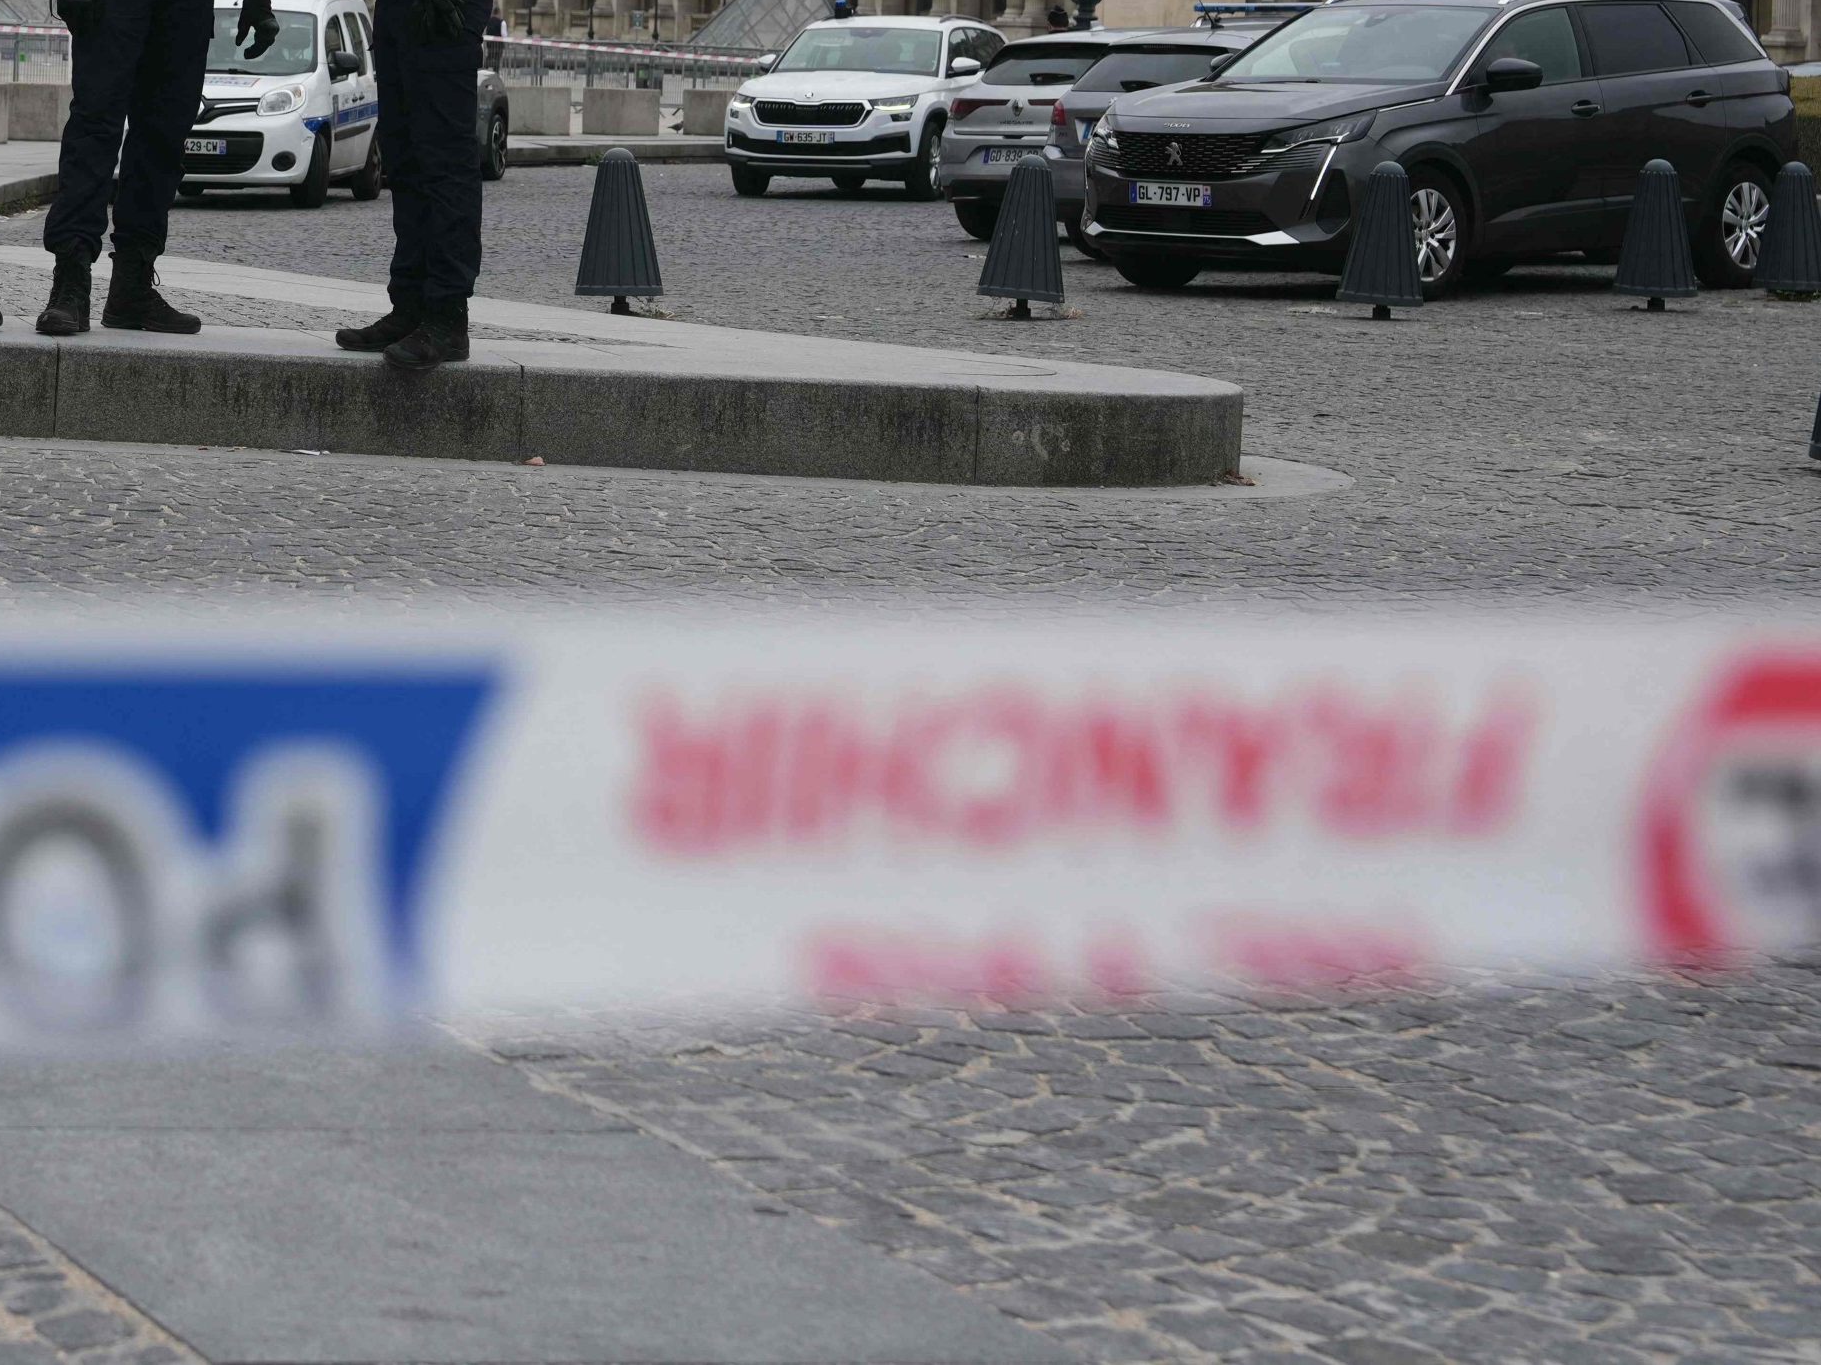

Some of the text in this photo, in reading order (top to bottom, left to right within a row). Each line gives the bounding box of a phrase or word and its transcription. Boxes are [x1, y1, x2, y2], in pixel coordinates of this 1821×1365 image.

[783, 132, 827, 143] GW-635-JT
[989, 149, 1039, 163] GD-839
[1139, 186, 1200, 203] GL-797-VP
